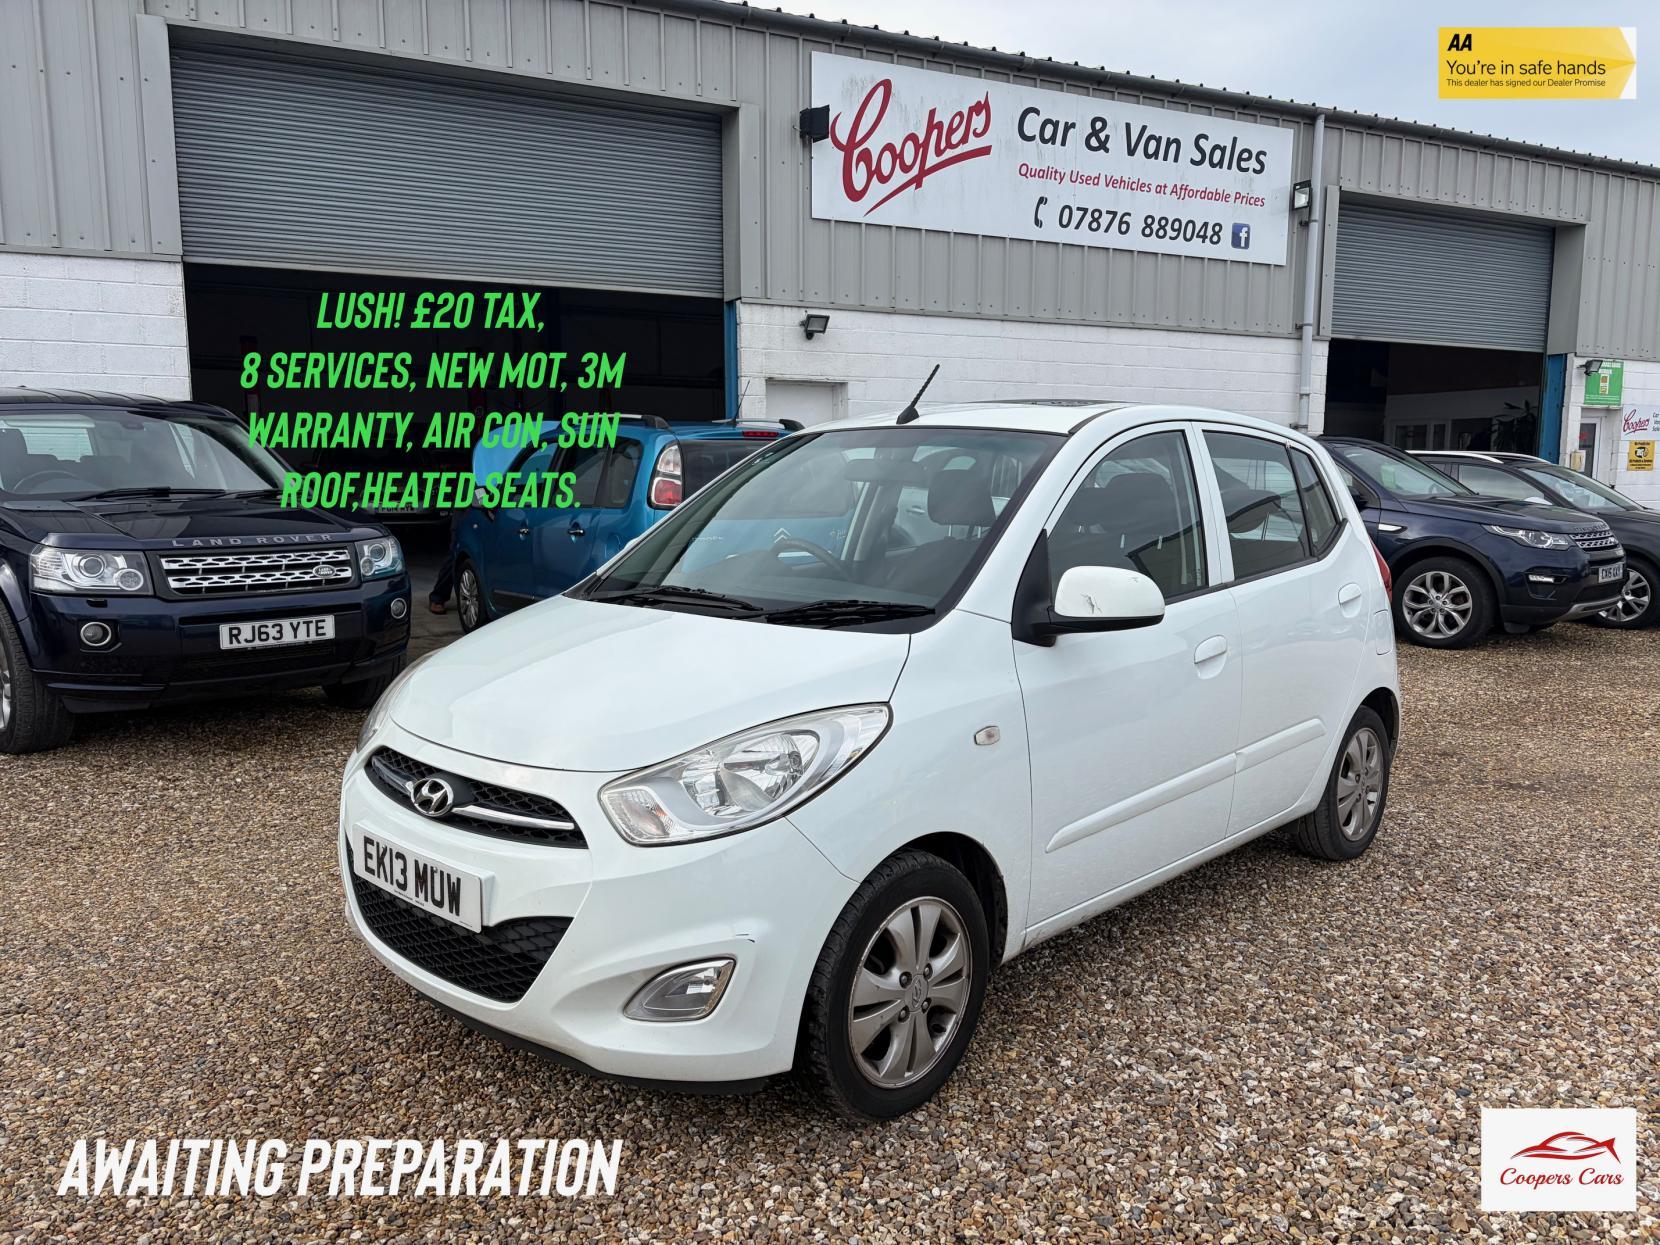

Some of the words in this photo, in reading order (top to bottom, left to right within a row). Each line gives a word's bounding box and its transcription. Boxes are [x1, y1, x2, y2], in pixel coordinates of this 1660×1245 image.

[829, 78, 992, 205] Coopers
[1018, 107, 1075, 147] Car
[1084, 115, 1110, 154] &
[1125, 121, 1182, 163] Van
[1190, 133, 1268, 175] Sales
[1018, 162, 1065, 184] Quality
[1069, 170, 1101, 187] Used
[1104, 174, 1152, 193] Vehicles
[1155, 181, 1168, 195] at
[1170, 184, 1231, 204] Affordable
[1233, 191, 1265, 207] Prices
[1058, 204, 1132, 236] 07876
[1141, 214, 1223, 246] 889048
[172, 538, 242, 548] LAND
[256, 534, 334, 544] ROVER
[228, 623, 284, 645] RJ63
[289, 619, 327, 639] YTE
[363, 835, 408, 892] EK13
[414, 858, 462, 917] MUW
